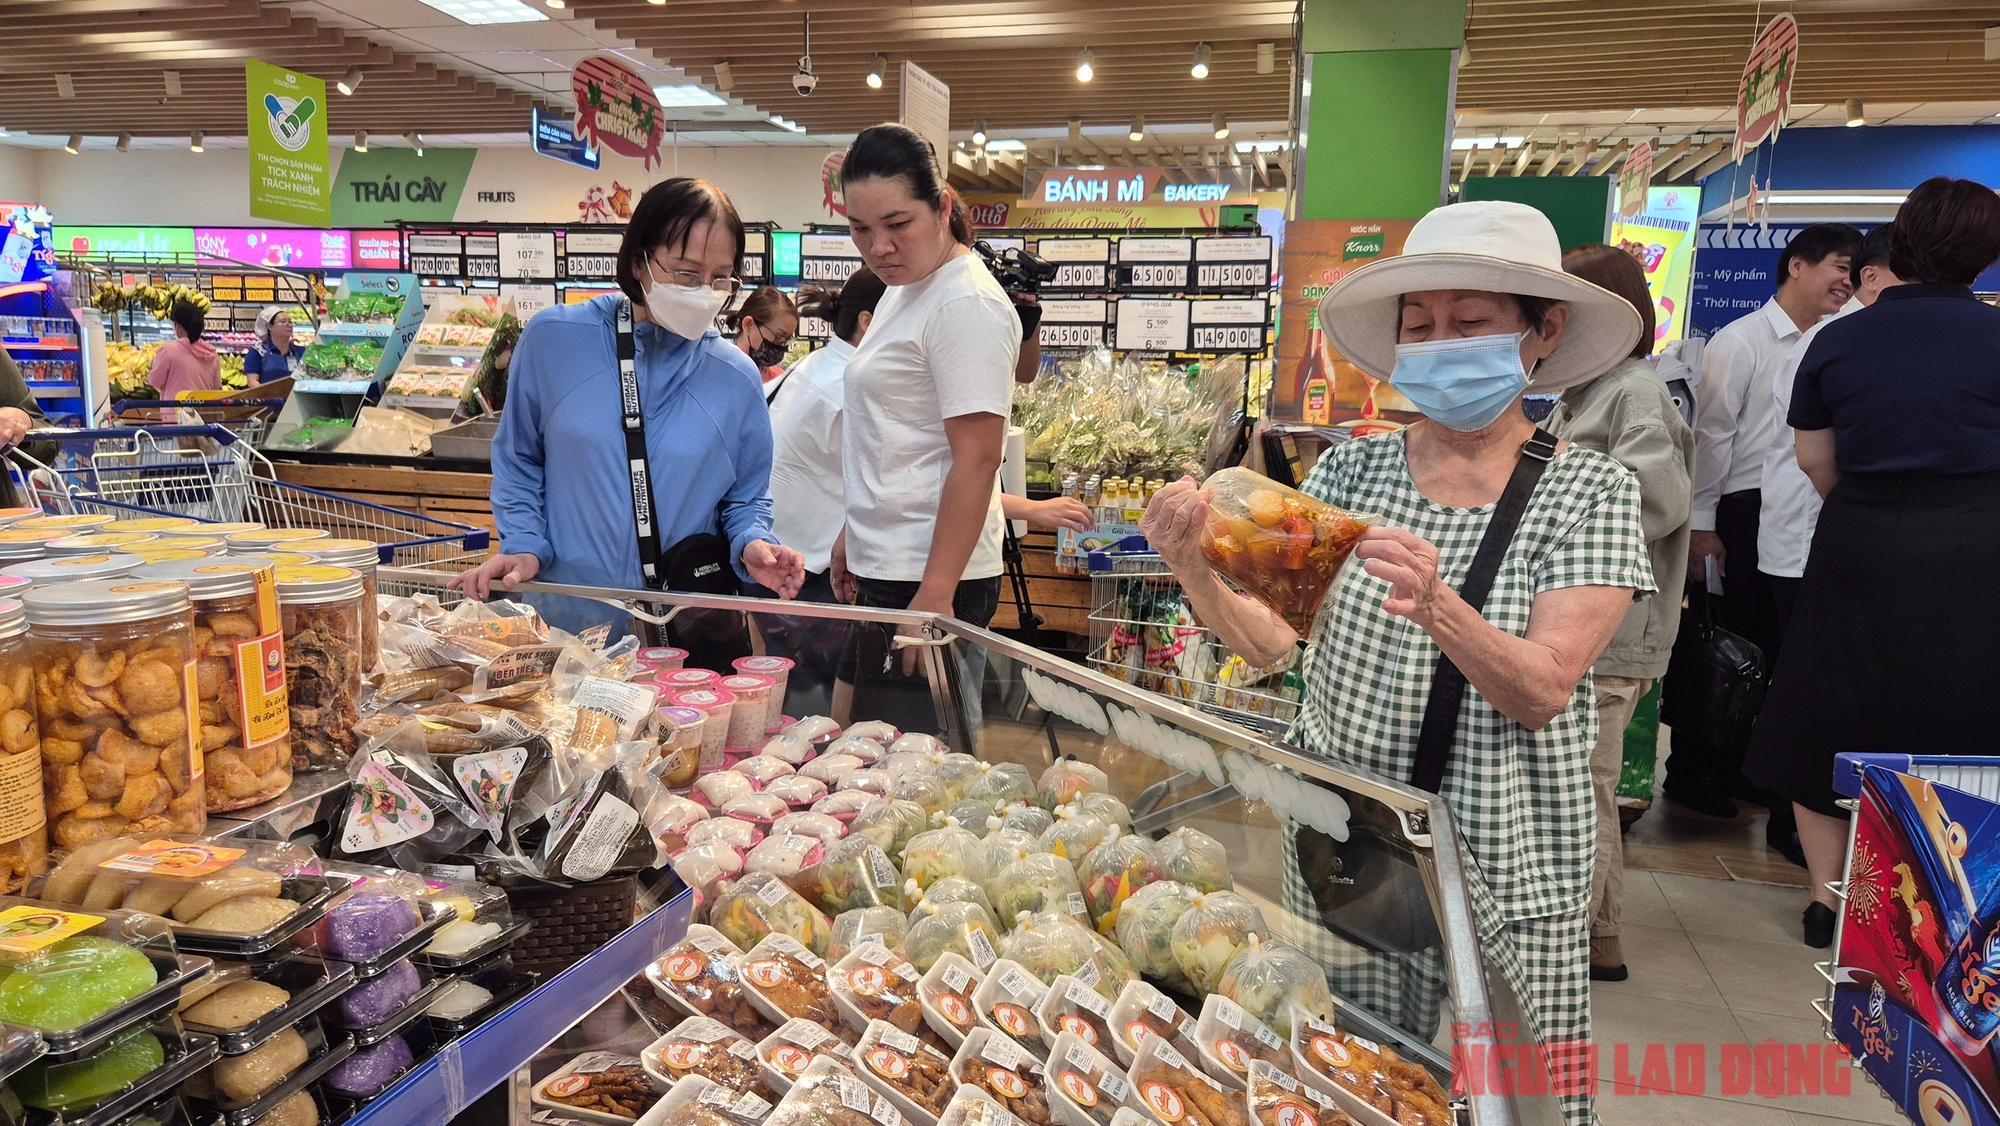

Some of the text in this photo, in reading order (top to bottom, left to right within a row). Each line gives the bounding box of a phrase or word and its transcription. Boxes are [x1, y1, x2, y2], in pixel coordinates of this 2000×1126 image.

[594, 111, 649, 148] CHRISTMAS
[257, 152, 269, 163] TIN
[267, 165, 315, 184] TICK XANH
[261, 175, 321, 198] TRÁCH NHIỆM
[350, 174, 515, 203] TRÁI CÂY FRUITS
[1045, 174, 1231, 202] BÁNH MÌ BAKERY
[970, 205, 1002, 225] Otto
[1344, 240, 1382, 254] Knorr
[569, 259, 612, 272] 35.000
[805, 263, 852, 276] 21.900
[1133, 269, 1175, 281] 6.500
[1201, 269, 1253, 281] 11.500
[1713, 269, 1732, 283] Mỹ
[1733, 267, 1767, 283] phẩm
[361, 280, 384, 288] Select
[1703, 297, 1729, 309] Thời
[1732, 298, 1761, 311] trang
[1040, 329, 1091, 342] 26.500
[1196, 332, 1248, 344] 14.900
[622, 371, 634, 416] HERBALIFE
[628, 370, 641, 416] NUTRITION
[633, 470, 643, 515] HERBALIFE
[639, 470, 650, 515] NUTRITION
[1957, 922, 2000, 1016] Tige
[1945, 980, 1976, 1031] LAGER BEER
[1851, 1003, 1895, 1064] Tiger
